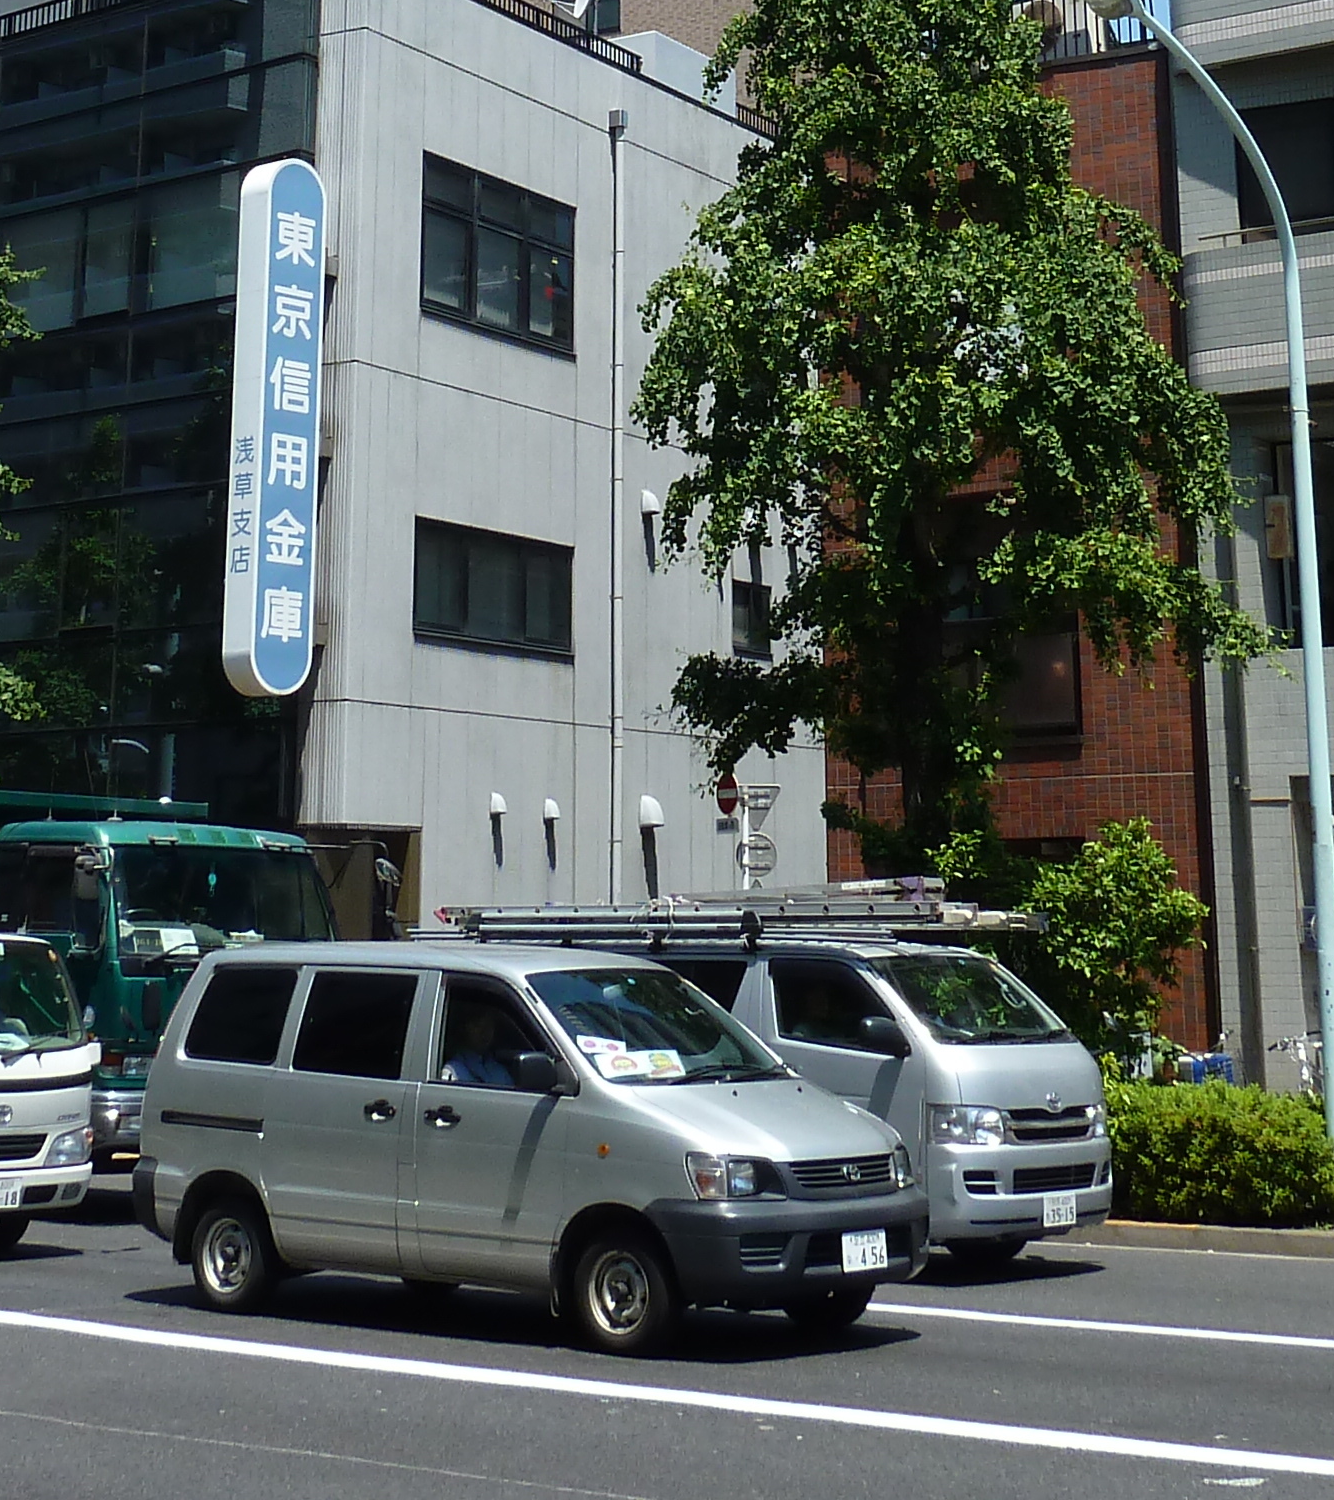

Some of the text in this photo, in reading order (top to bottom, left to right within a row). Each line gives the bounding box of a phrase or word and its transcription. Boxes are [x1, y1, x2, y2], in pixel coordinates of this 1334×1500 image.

[230, 435, 255, 574] 浅草支店
[260, 211, 317, 643] 東京信用金庫
